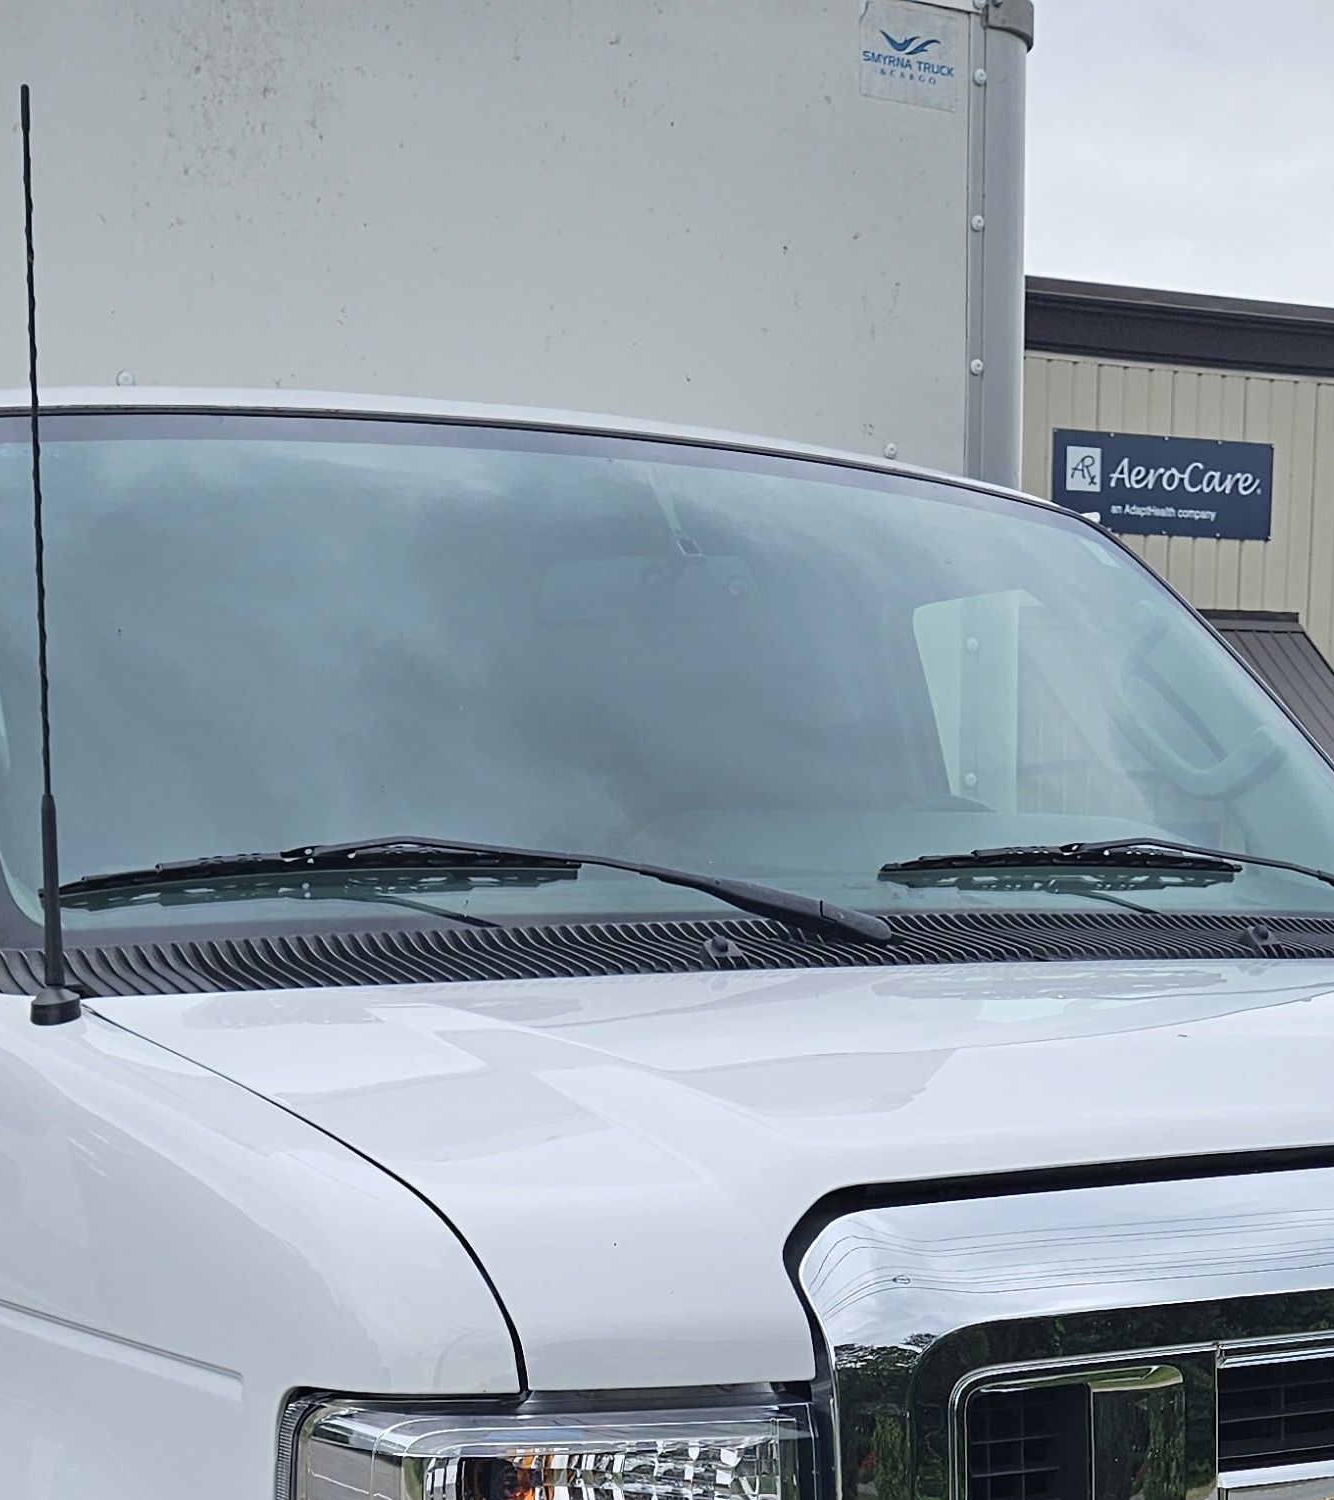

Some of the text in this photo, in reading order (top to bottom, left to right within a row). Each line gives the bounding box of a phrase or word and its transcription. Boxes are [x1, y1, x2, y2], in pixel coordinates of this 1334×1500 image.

[862, 50, 955, 77] SMYRNA TRUCK
[890, 69, 937, 85] CARGO
[1109, 457, 1261, 496] AeroCare
[1110, 503, 1217, 522] an AdaptHealth company
